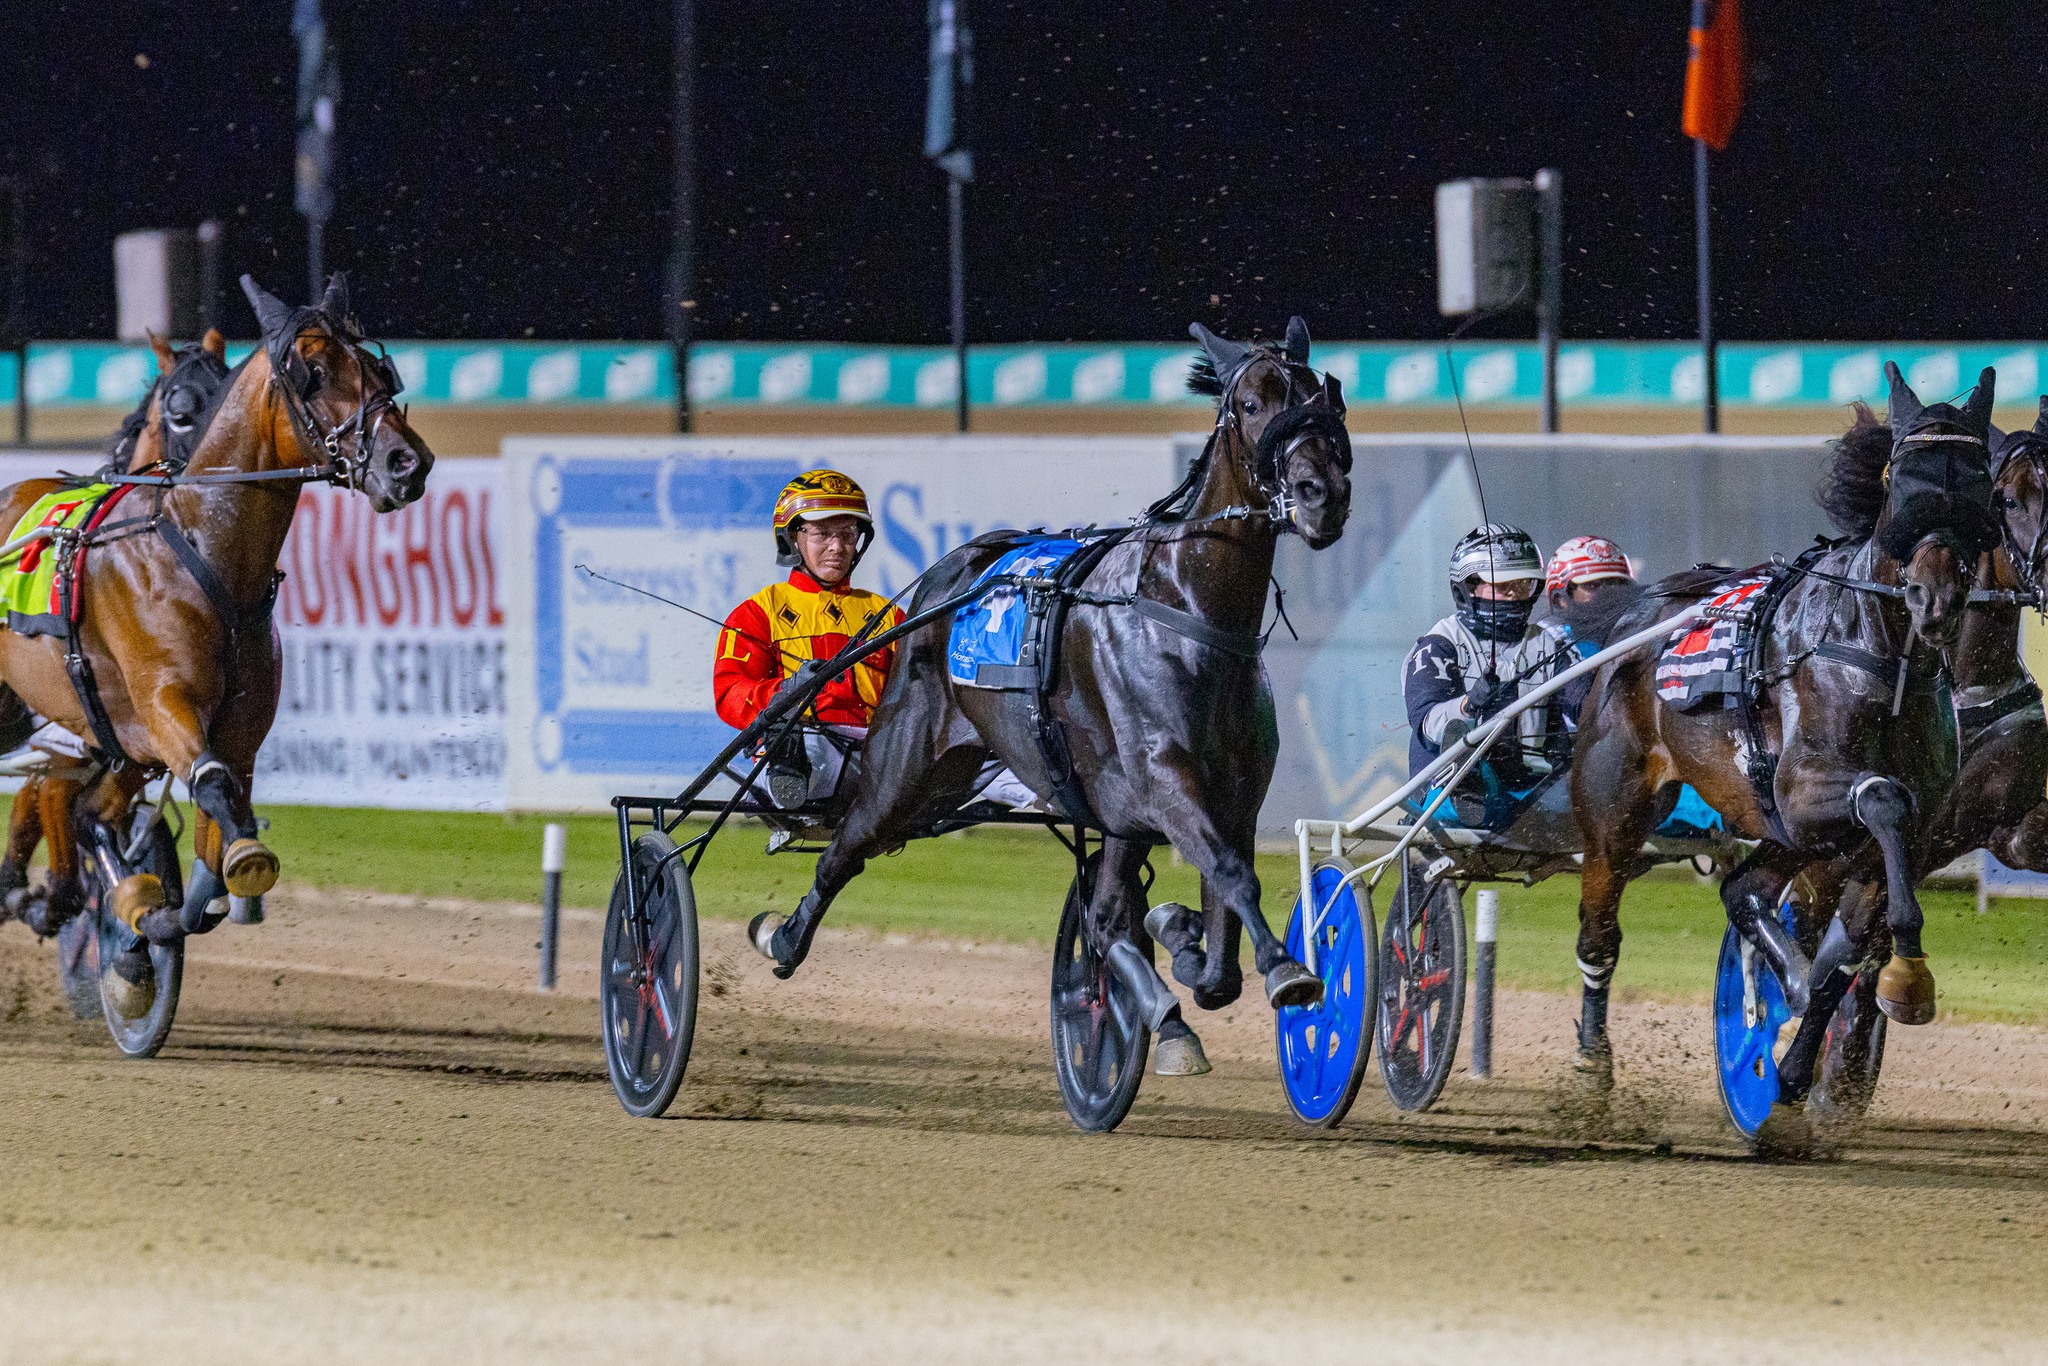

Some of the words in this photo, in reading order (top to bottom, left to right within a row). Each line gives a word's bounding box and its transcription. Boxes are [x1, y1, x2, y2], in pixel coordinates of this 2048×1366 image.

[281, 490, 504, 627] ONGHOL
[719, 627, 751, 663] L
[1413, 643, 1455, 681] TY
